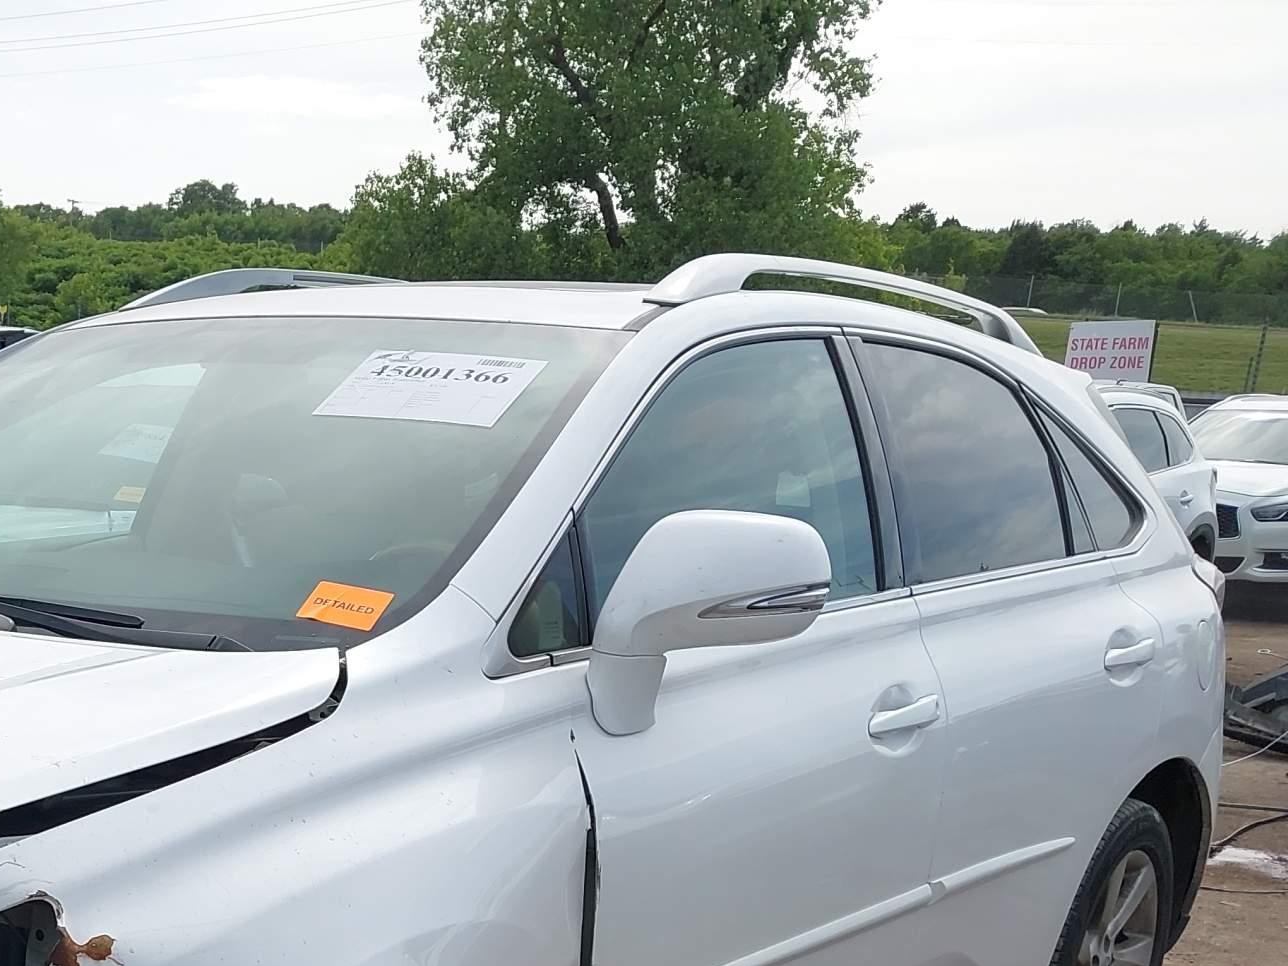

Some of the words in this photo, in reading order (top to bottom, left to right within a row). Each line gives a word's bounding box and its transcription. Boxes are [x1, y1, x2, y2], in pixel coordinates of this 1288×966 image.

[1071, 338, 1109, 351] STATE
[1112, 337, 1150, 350] FARM
[1070, 357, 1106, 370] DROP
[1110, 356, 1145, 369] ZONE
[370, 364, 513, 385] 45001366
[313, 597, 375, 615] DETAILED
